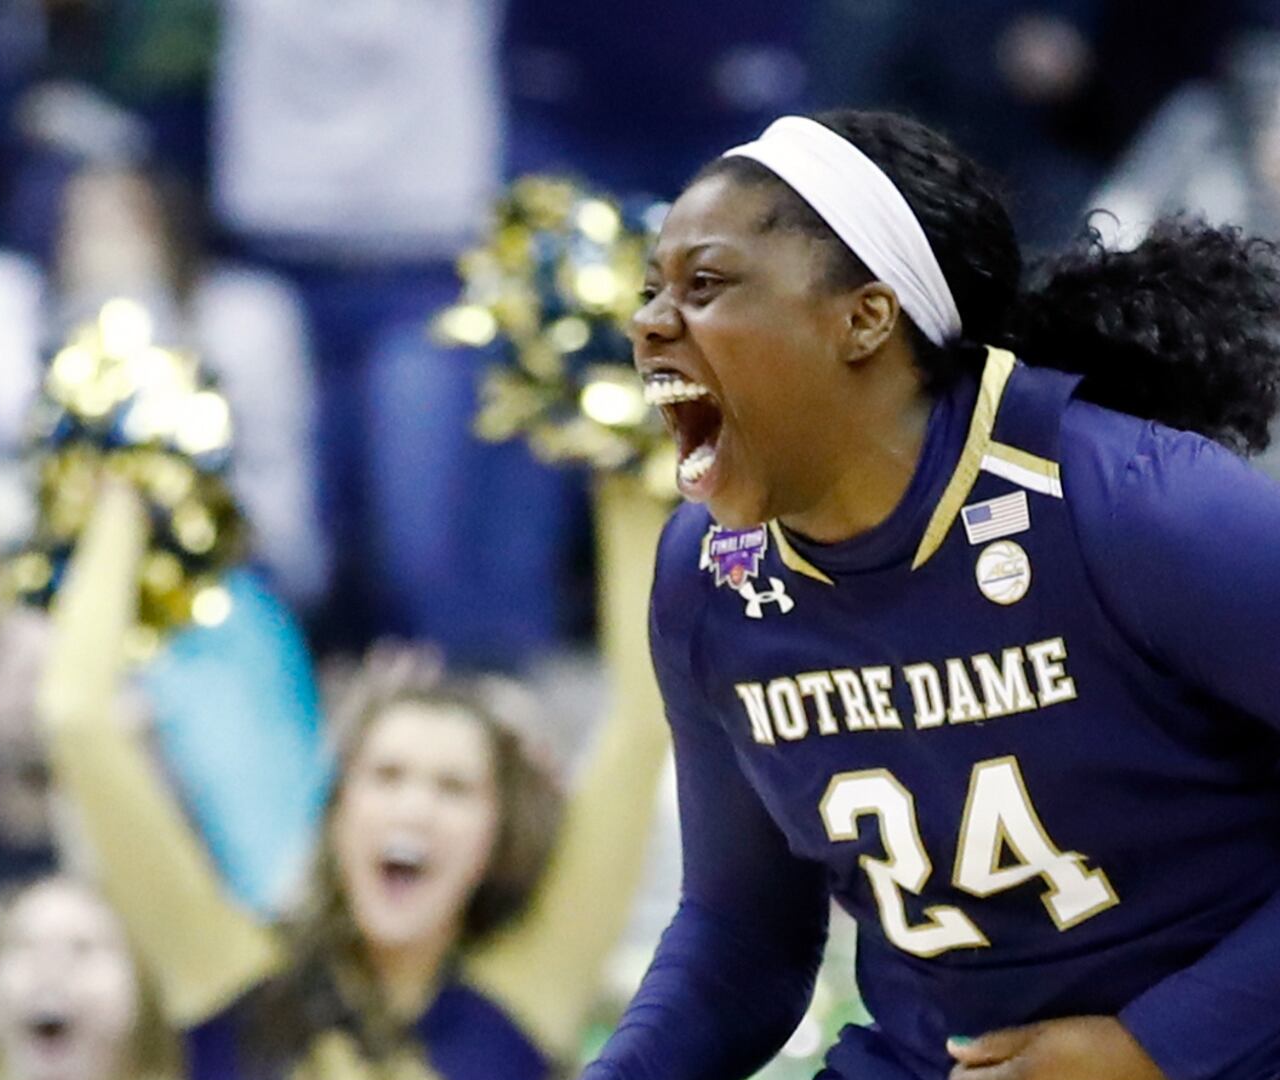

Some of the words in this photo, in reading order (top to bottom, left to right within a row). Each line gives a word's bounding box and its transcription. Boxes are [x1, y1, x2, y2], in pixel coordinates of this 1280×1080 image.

[735, 667, 903, 745] NOTRE
[904, 637, 1078, 729] DAME
[819, 755, 1120, 958] 24
